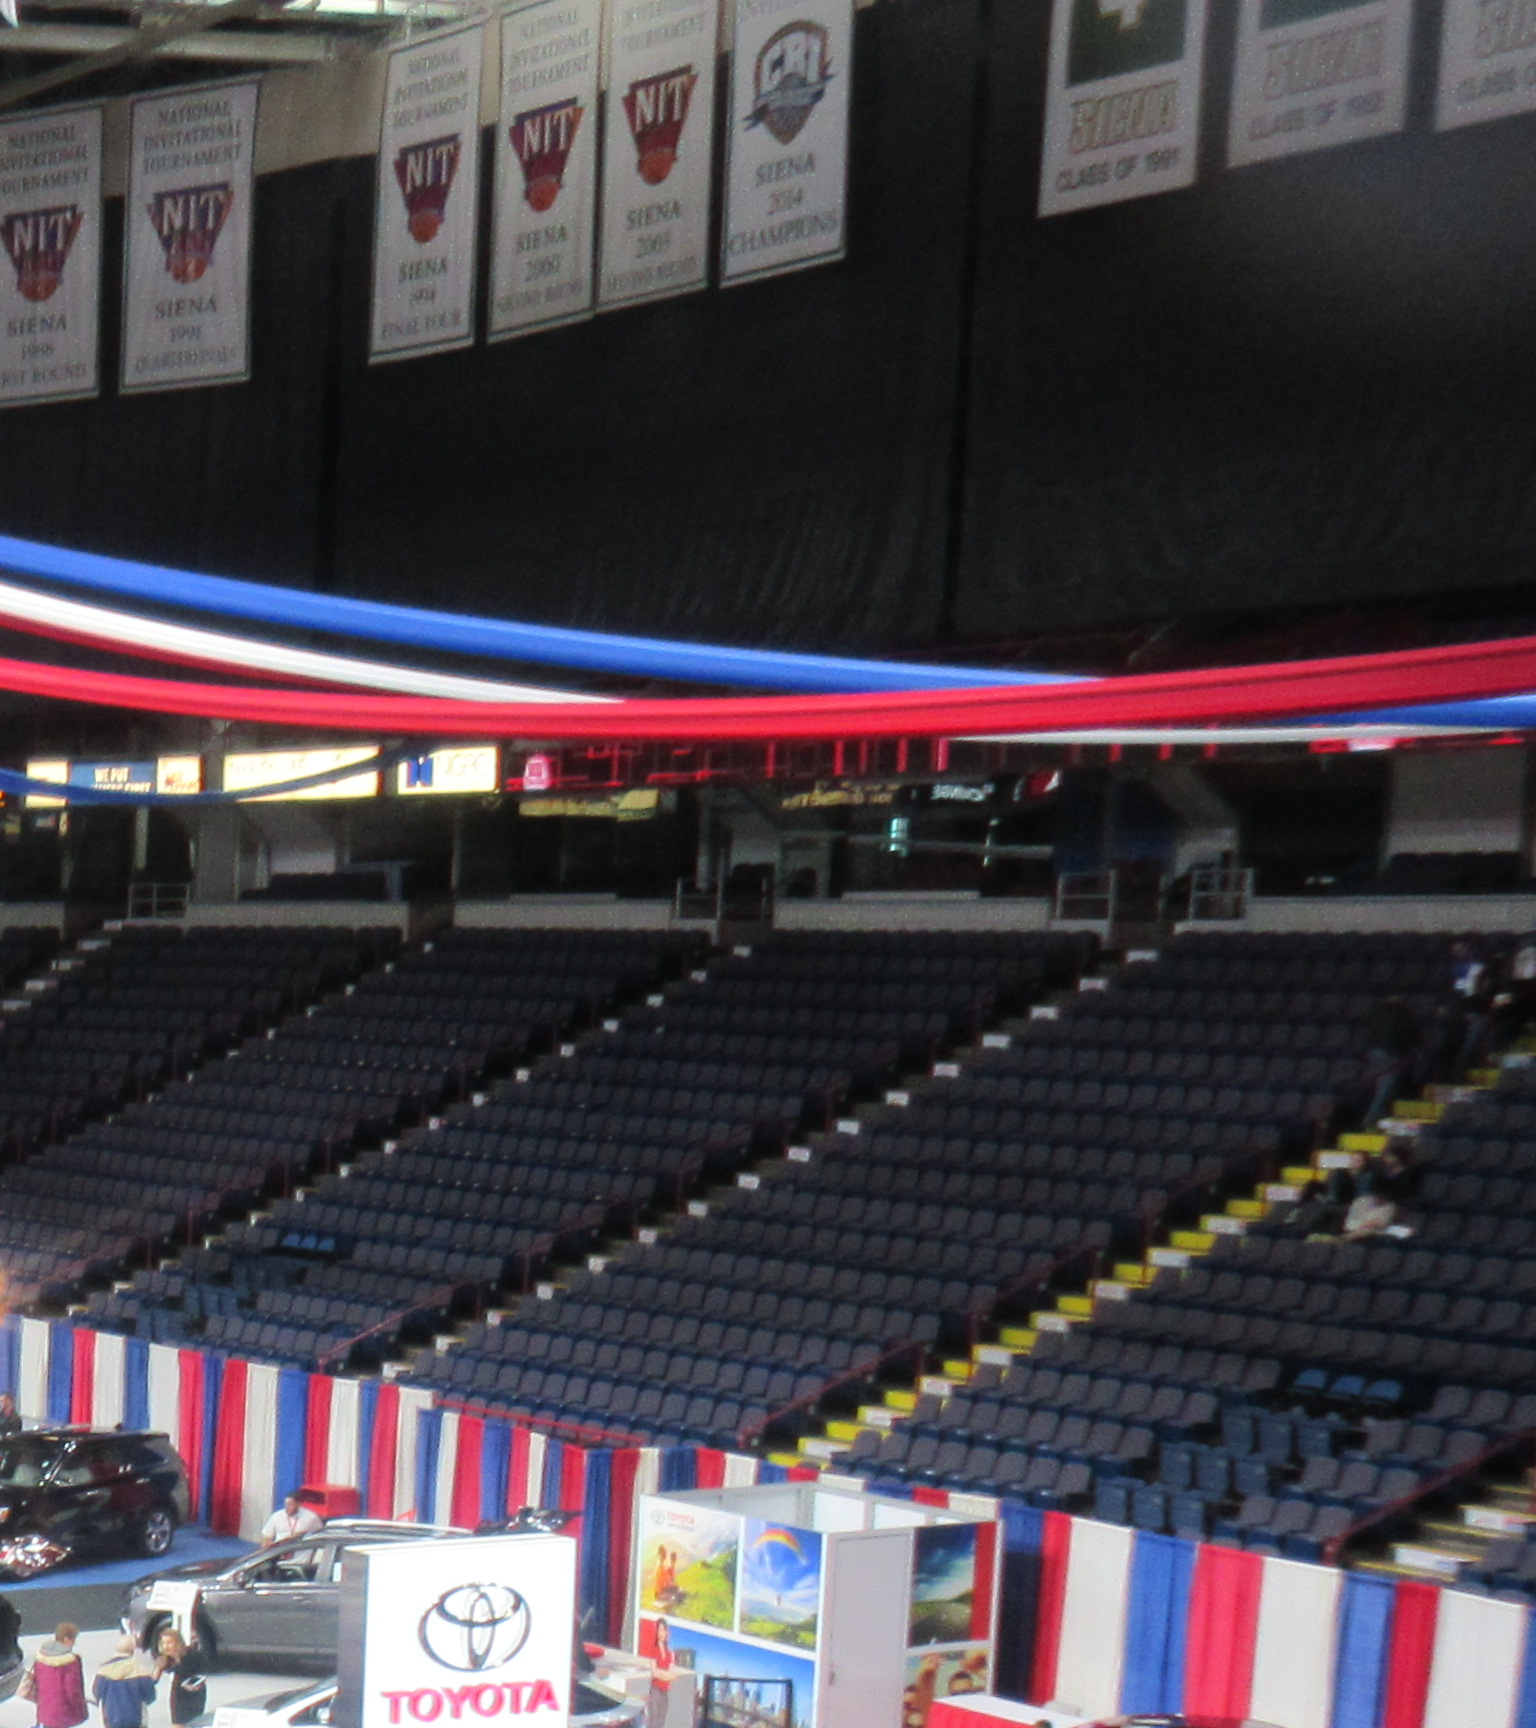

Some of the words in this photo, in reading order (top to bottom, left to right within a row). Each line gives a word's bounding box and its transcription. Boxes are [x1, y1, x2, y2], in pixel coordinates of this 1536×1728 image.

[632, 78, 688, 134] NIT
[522, 109, 573, 161] NIT
[405, 145, 455, 194] NIT
[755, 153, 816, 188] SIENA
[13, 208, 73, 258] NIT
[161, 188, 227, 236] NIT
[729, 209, 837, 257] CHAMPIONS
[8, 315, 68, 337] SIENA
[155, 297, 217, 319] SIENA
[380, 1679, 560, 1725] TOYOTA
